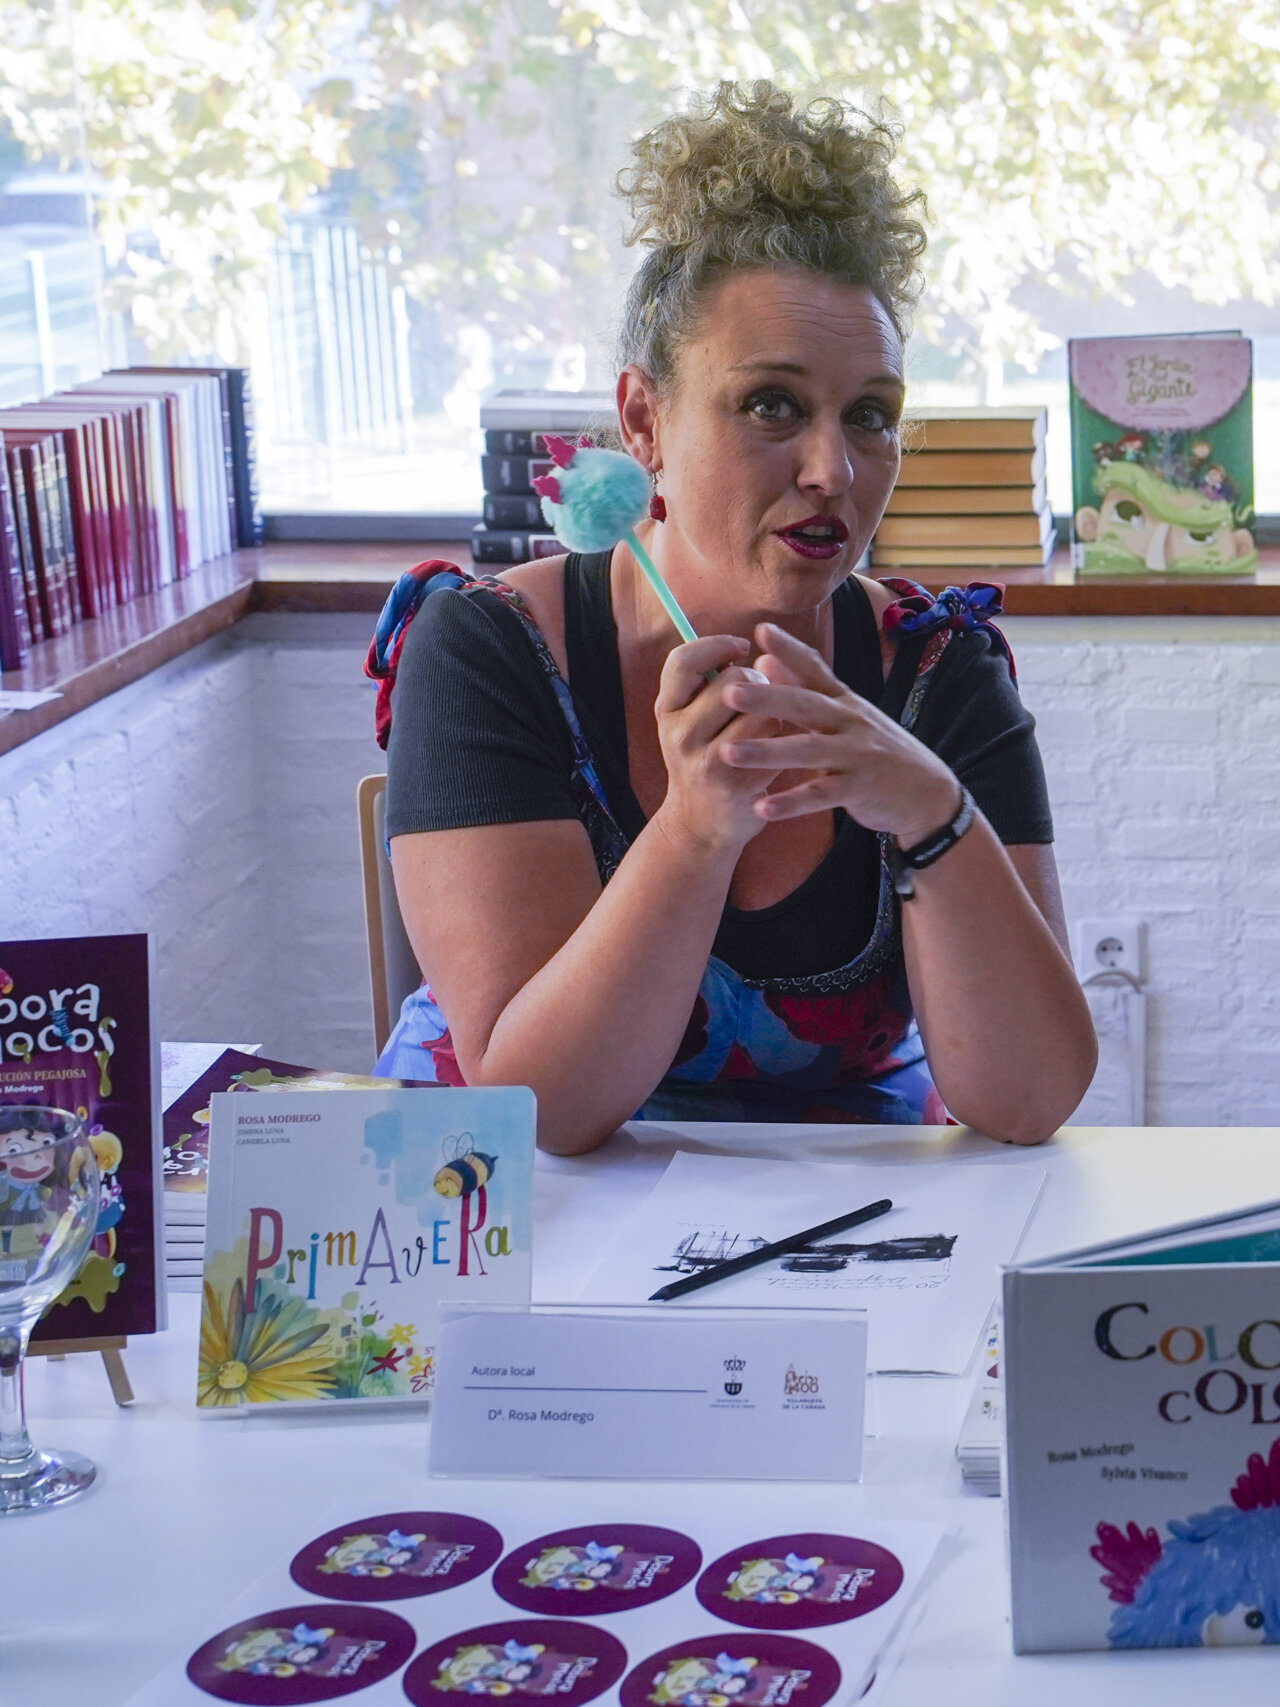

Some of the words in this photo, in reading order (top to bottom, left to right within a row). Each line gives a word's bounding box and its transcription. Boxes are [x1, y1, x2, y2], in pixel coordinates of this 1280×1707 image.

[0, 1017, 117, 1065] ocos
[34, 1069, 87, 1080] PEGAJOSA
[4, 1085, 44, 1094] Modrego
[238, 1116, 265, 1125] ROSA
[267, 1114, 321, 1124] MODREGO
[471, 1360, 508, 1376] Autora
[509, 1360, 536, 1376] local
[508, 1408, 537, 1421] Rosa
[540, 1409, 595, 1424] Modrego
[1048, 1450, 1077, 1463] Rosa
[1081, 1442, 1135, 1458] Modrego
[1101, 1466, 1137, 1482] Sylvia
[1140, 1466, 1188, 1480] Vivanco
